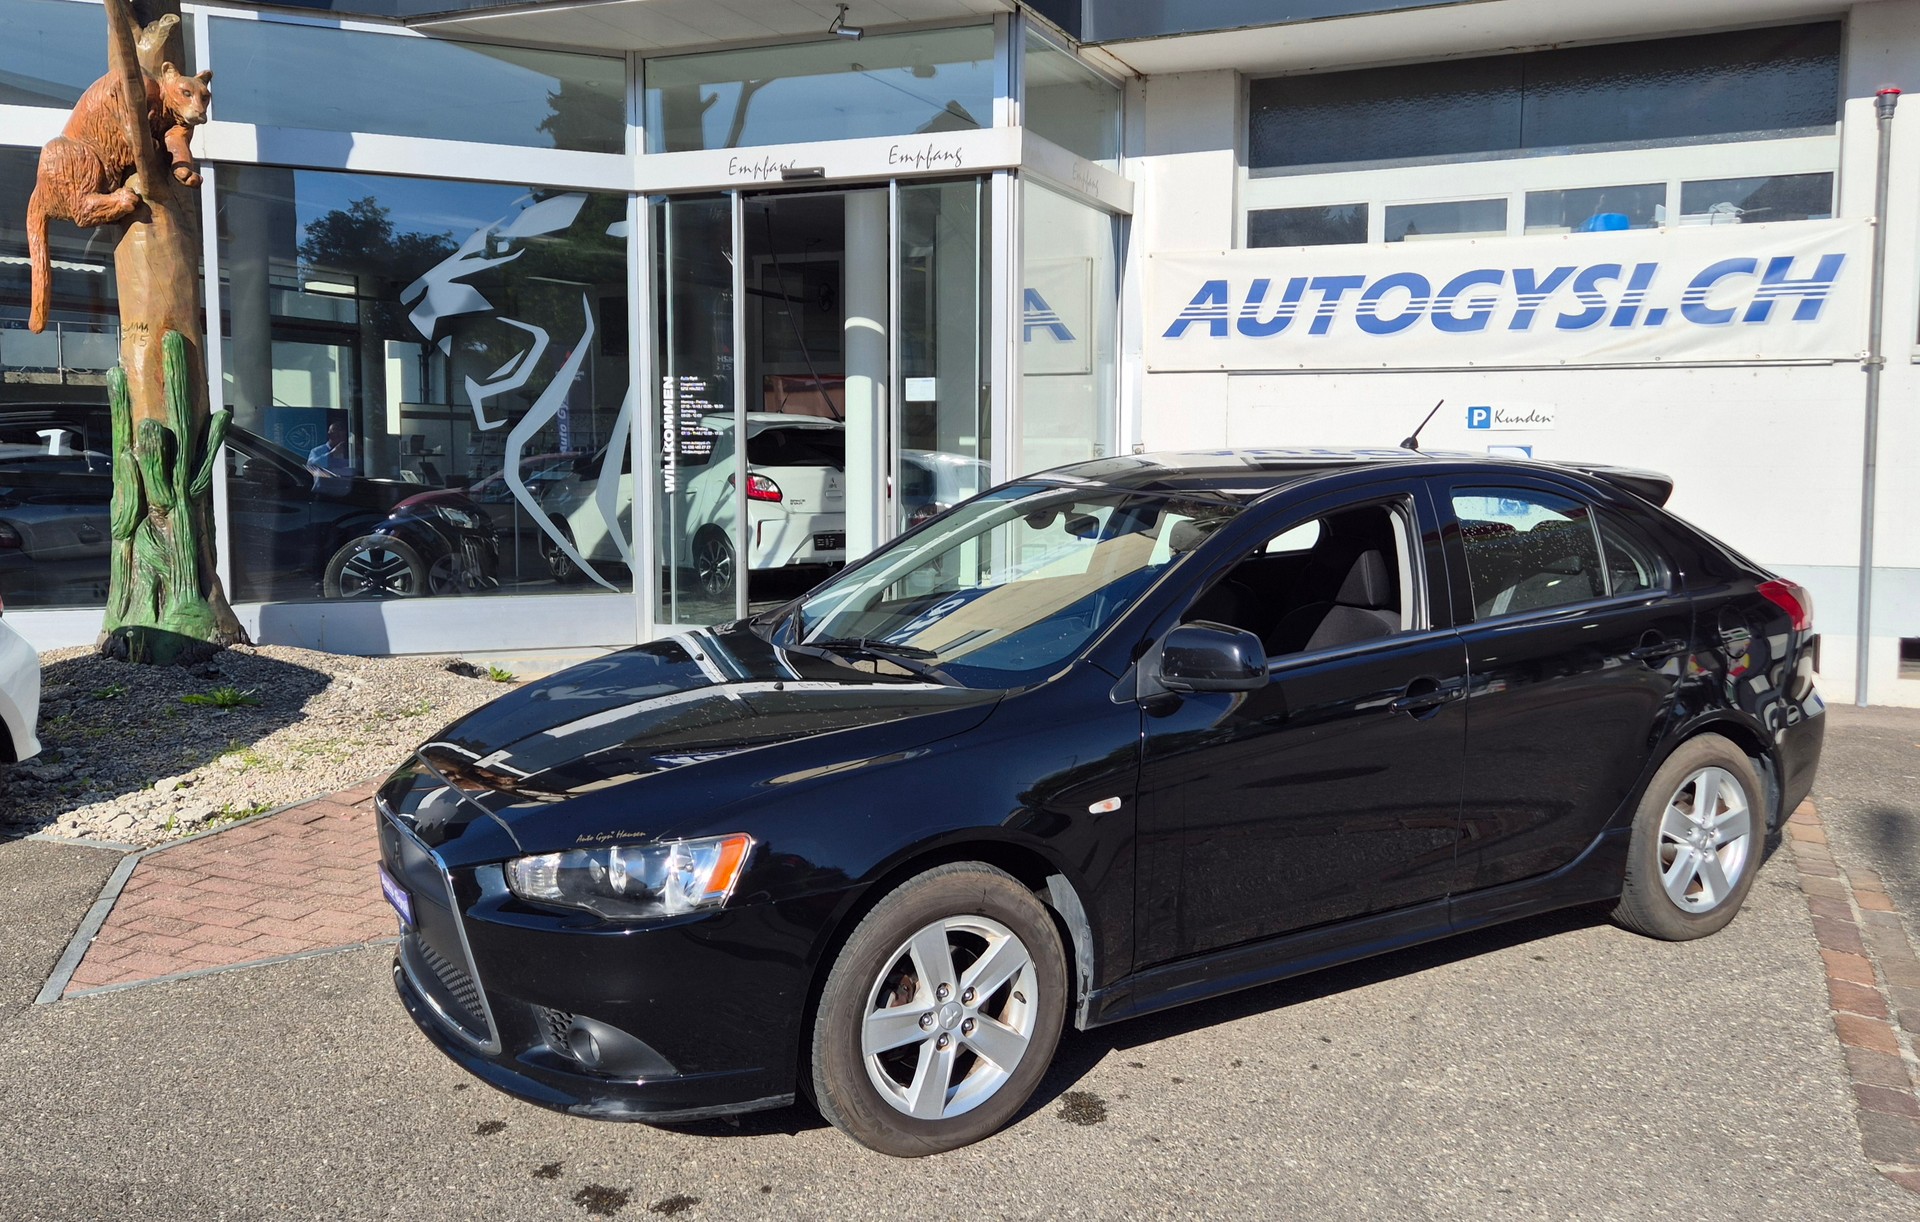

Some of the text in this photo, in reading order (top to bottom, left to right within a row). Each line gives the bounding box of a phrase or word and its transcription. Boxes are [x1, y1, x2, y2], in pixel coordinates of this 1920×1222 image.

[888, 143, 962, 169] Empfang
[1162, 253, 1846, 339] AUTOGYSI.CH
[1494, 409, 1552, 423] Kunden
[663, 376, 675, 493] WILLKOMMEN
[576, 834, 594, 843] Auto
